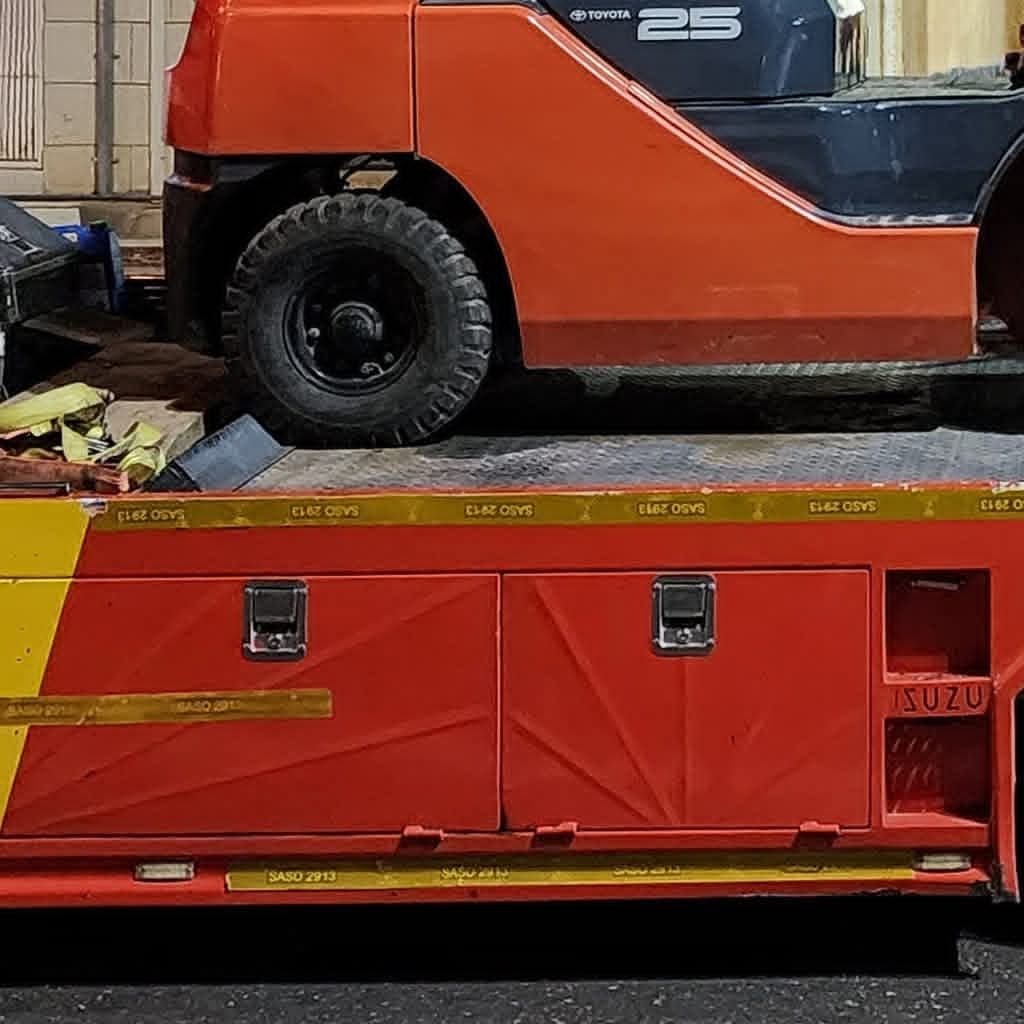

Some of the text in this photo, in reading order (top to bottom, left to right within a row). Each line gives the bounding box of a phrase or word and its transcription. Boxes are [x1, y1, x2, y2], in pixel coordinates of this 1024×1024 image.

[587, 6, 743, 41] TOYOTA 25
[324, 505, 359, 517] SASO
[500, 504, 534, 515] SASO
[671, 503, 706, 514] SASO
[842, 500, 877, 512] SASO
[151, 508, 185, 520] SASO
[894, 686, 984, 712] ISUZU
[268, 870, 337, 882] SASO 2913
